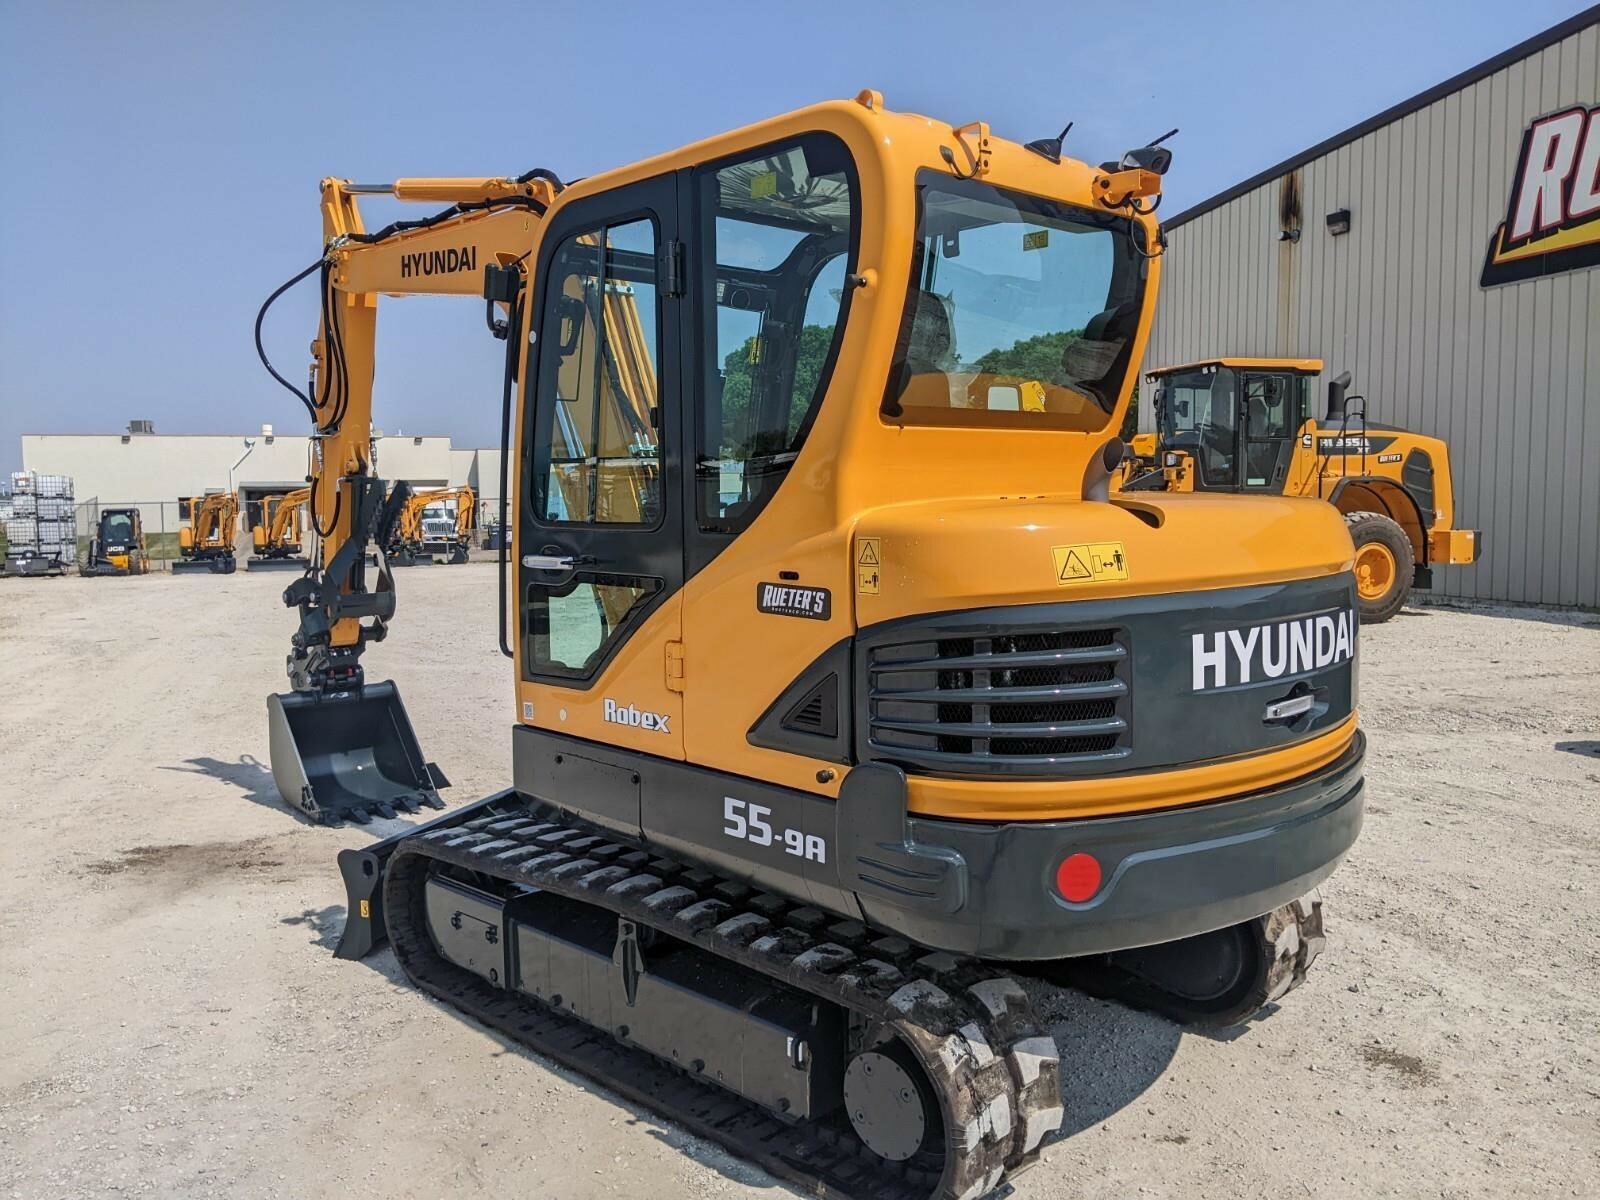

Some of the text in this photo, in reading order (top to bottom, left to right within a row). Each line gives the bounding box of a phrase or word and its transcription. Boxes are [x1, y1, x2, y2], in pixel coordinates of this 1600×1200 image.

[401, 246, 476, 278] HYUNDAI
[762, 584, 825, 613] RUETER'S
[1192, 609, 1354, 690] HYUNDAI
[603, 698, 671, 734] Robex
[724, 796, 826, 864] 55-9A
